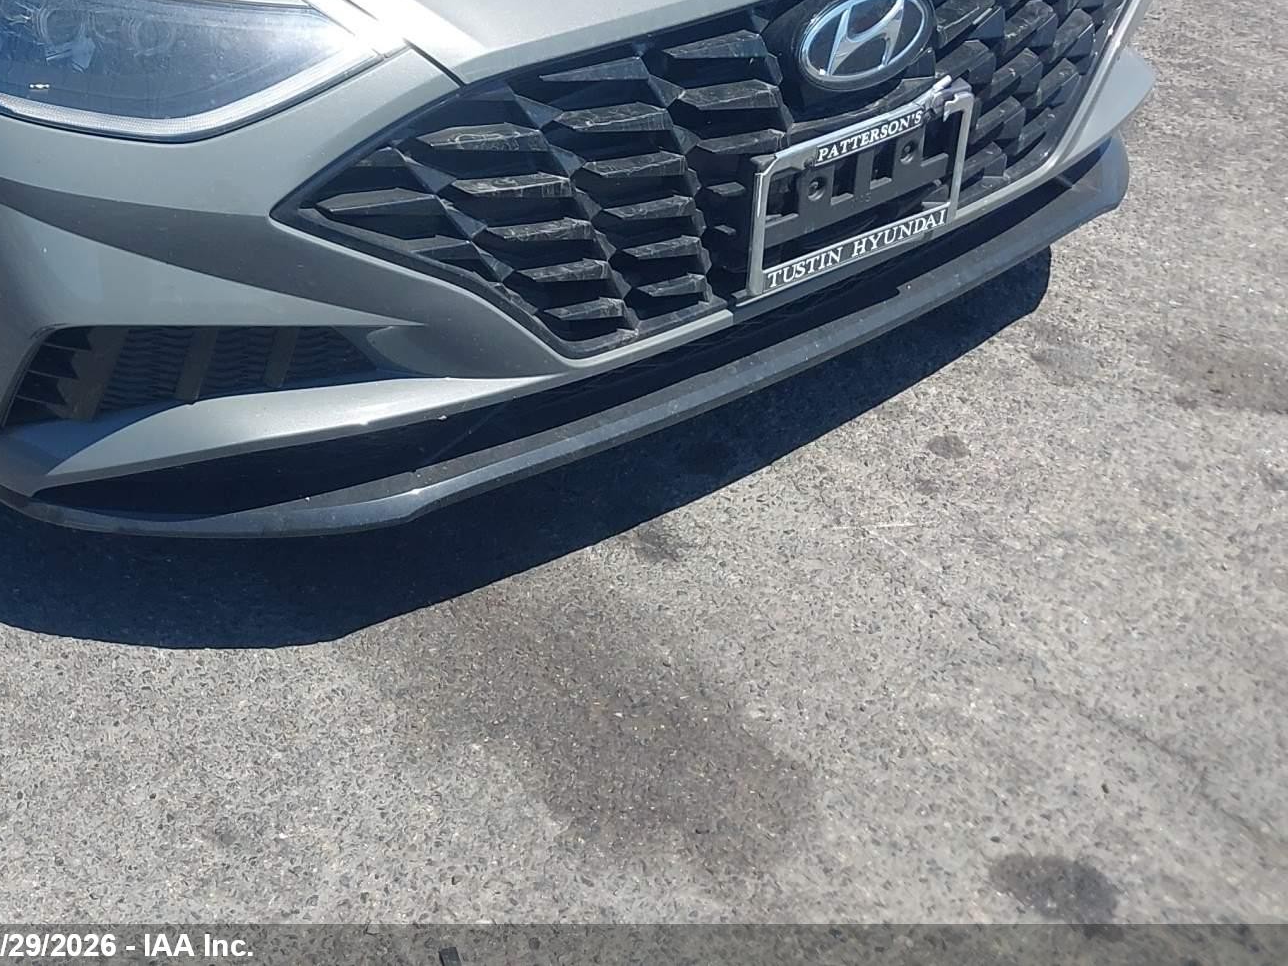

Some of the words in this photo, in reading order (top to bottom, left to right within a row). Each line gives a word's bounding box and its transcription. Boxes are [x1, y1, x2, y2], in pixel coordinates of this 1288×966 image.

[817, 110, 923, 162] PATTERSON'S
[767, 246, 843, 288] TUSTIN
[852, 209, 947, 258] HYUNDAI
